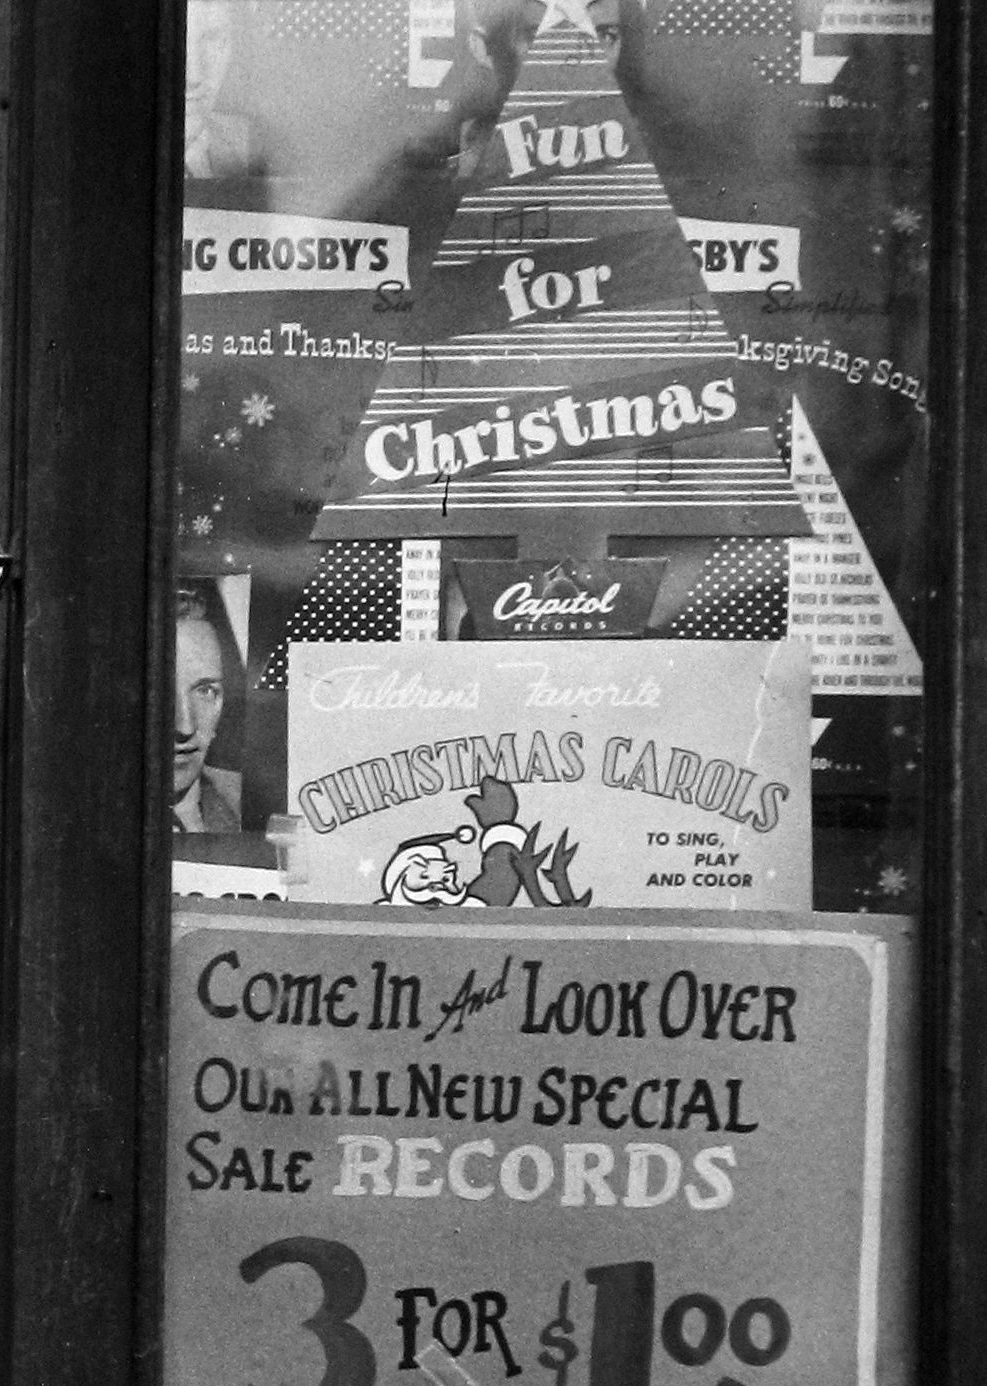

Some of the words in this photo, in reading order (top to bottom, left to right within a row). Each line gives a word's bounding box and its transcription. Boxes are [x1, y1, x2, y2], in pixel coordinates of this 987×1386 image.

[495, 114, 630, 179] Fun
[229, 237, 390, 272] CROSBY'S
[498, 256, 612, 321] for
[222, 328, 275, 356] and
[363, 377, 738, 483] Christmas
[492, 582, 621, 622] Capitol
[513, 620, 608, 632] RECORDS
[495, 660, 664, 708] Favorite
[298, 730, 586, 835] CHRISTMAS
[600, 736, 790, 834] CAROLS
[646, 831, 670, 846] TO
[676, 831, 724, 850] SING,
[694, 852, 740, 868] PLAY
[645, 872, 686, 888] AND
[692, 872, 753, 888] COLOR
[423, 954, 512, 1043] And
[330, 1132, 739, 1210] RECORDS
[393, 1286, 523, 1379] FOR
